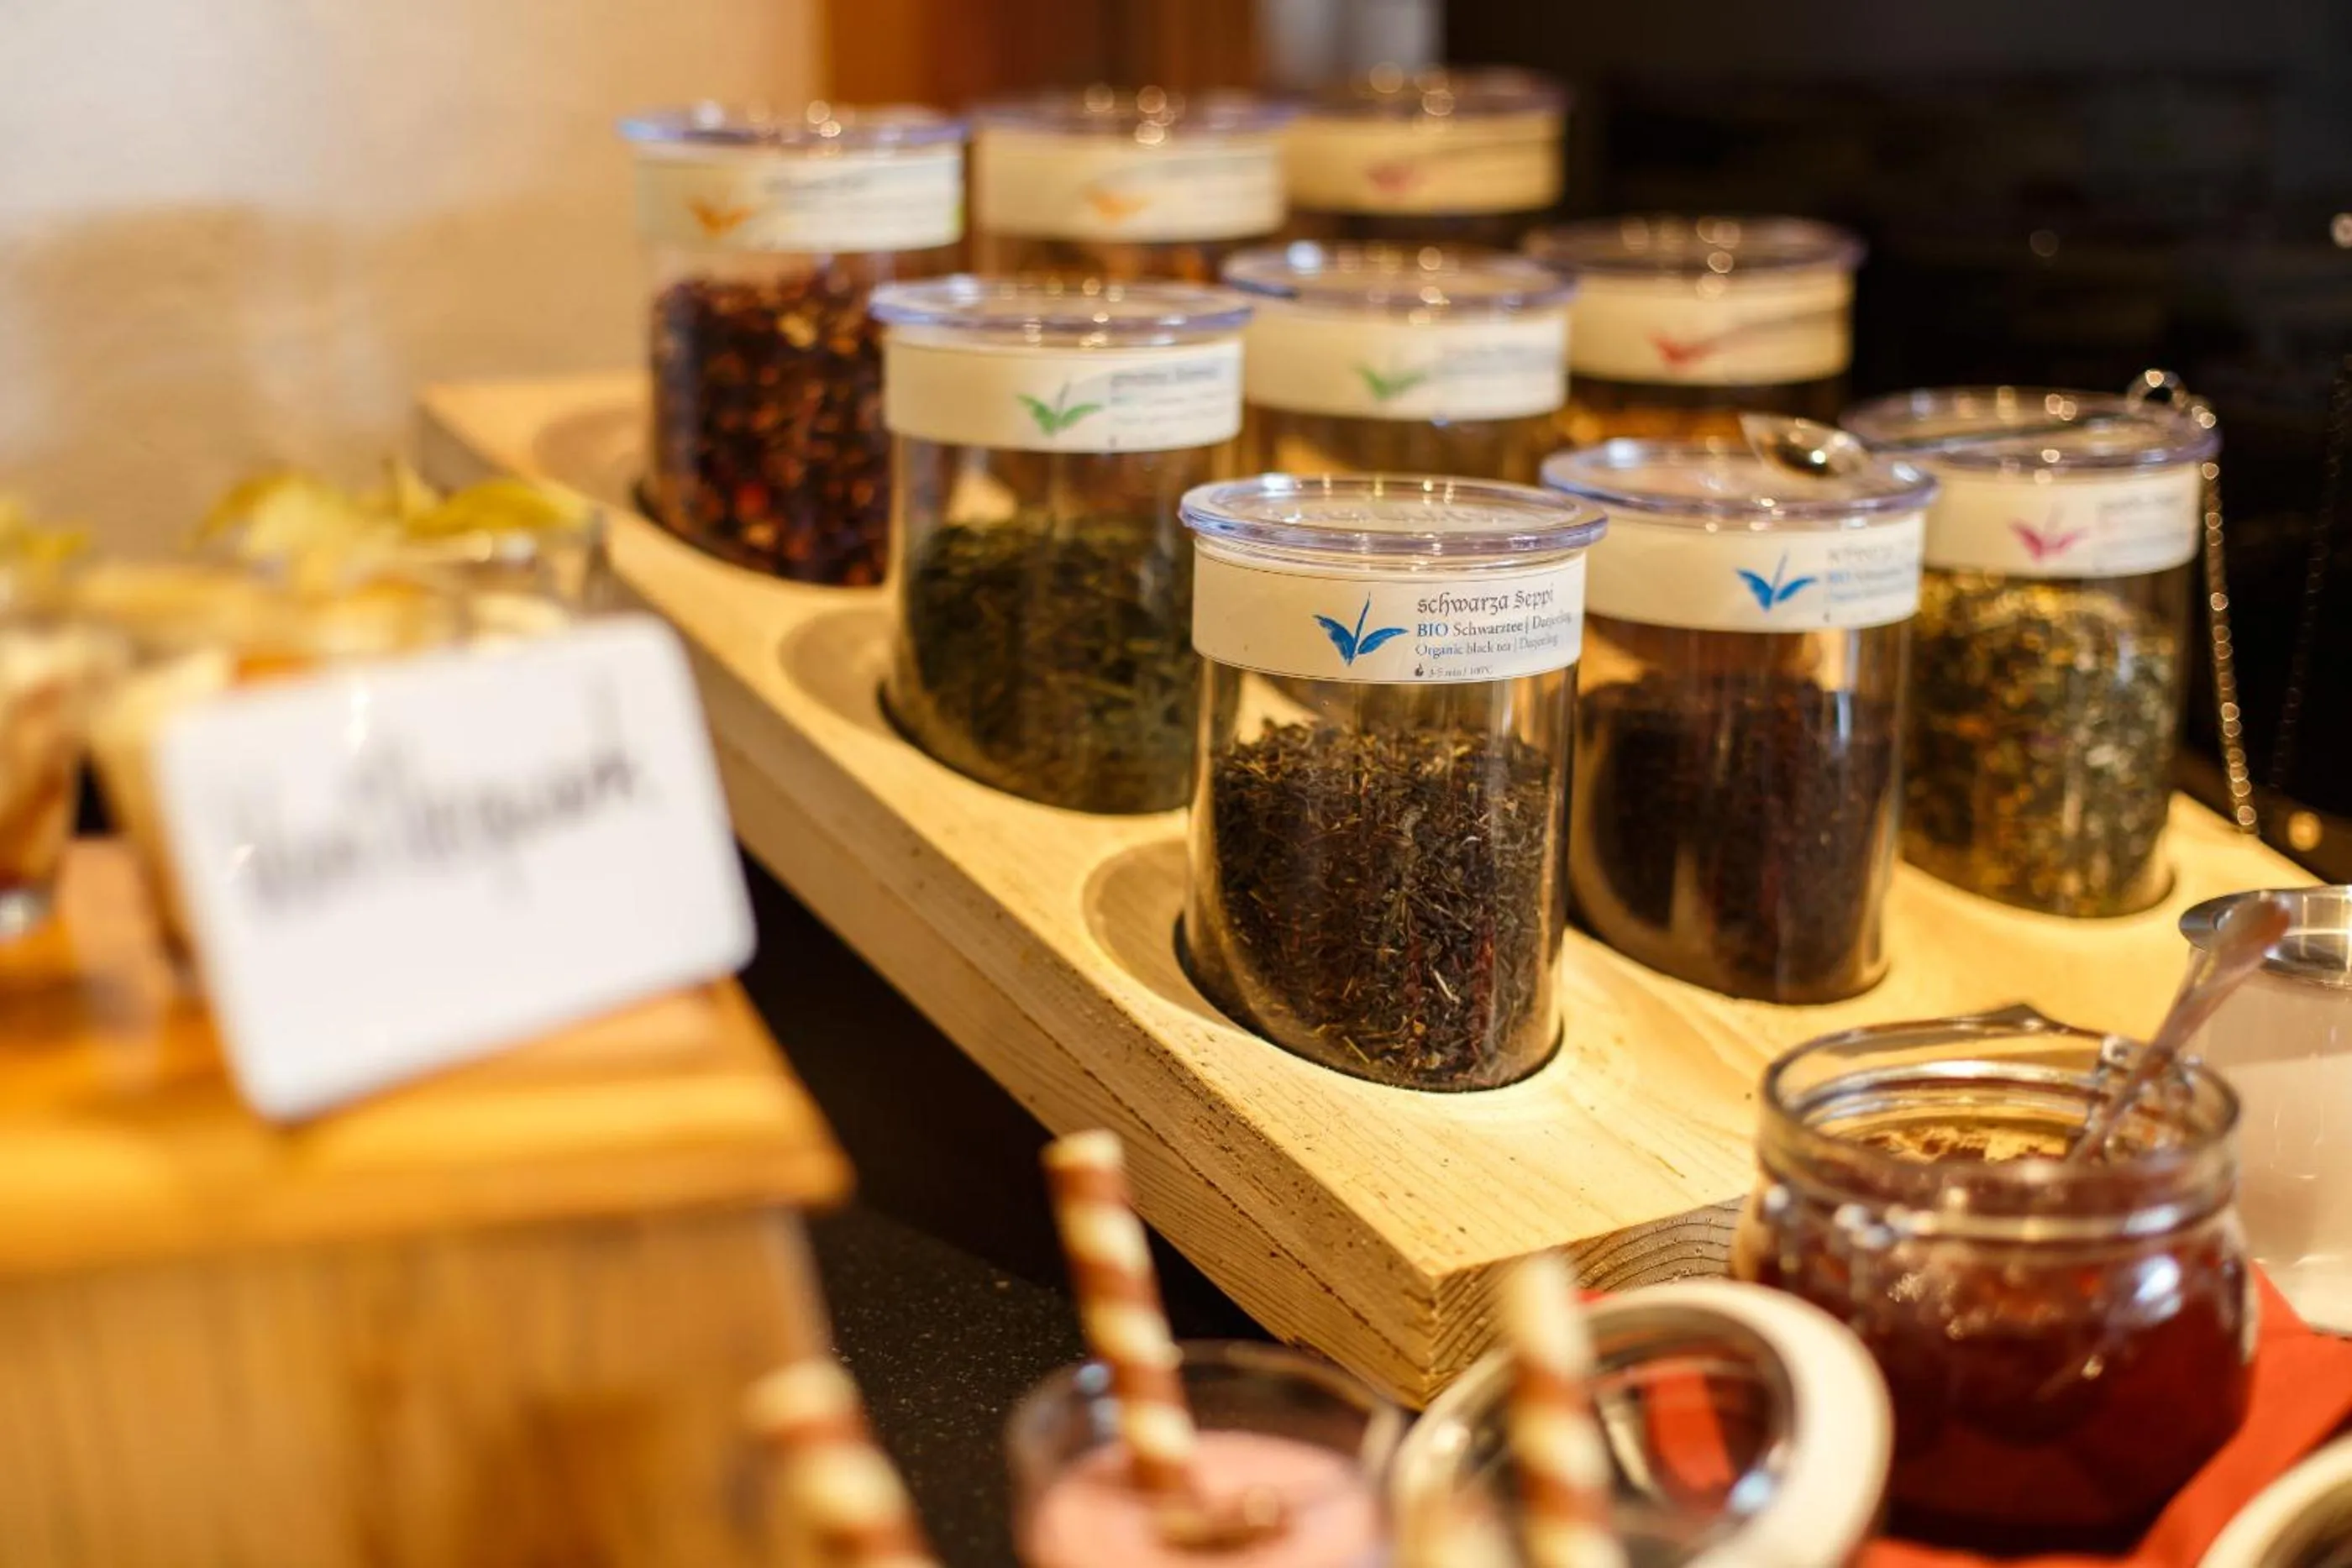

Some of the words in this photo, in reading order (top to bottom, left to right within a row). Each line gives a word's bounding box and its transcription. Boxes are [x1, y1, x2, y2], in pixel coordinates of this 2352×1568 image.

[1417, 591, 1509, 617] schwarza
[1417, 623, 1449, 637] BIO
[1453, 621, 1524, 637] Schwarztee
[1415, 643, 1463, 659] Organic
[1467, 640, 1494, 655] black
